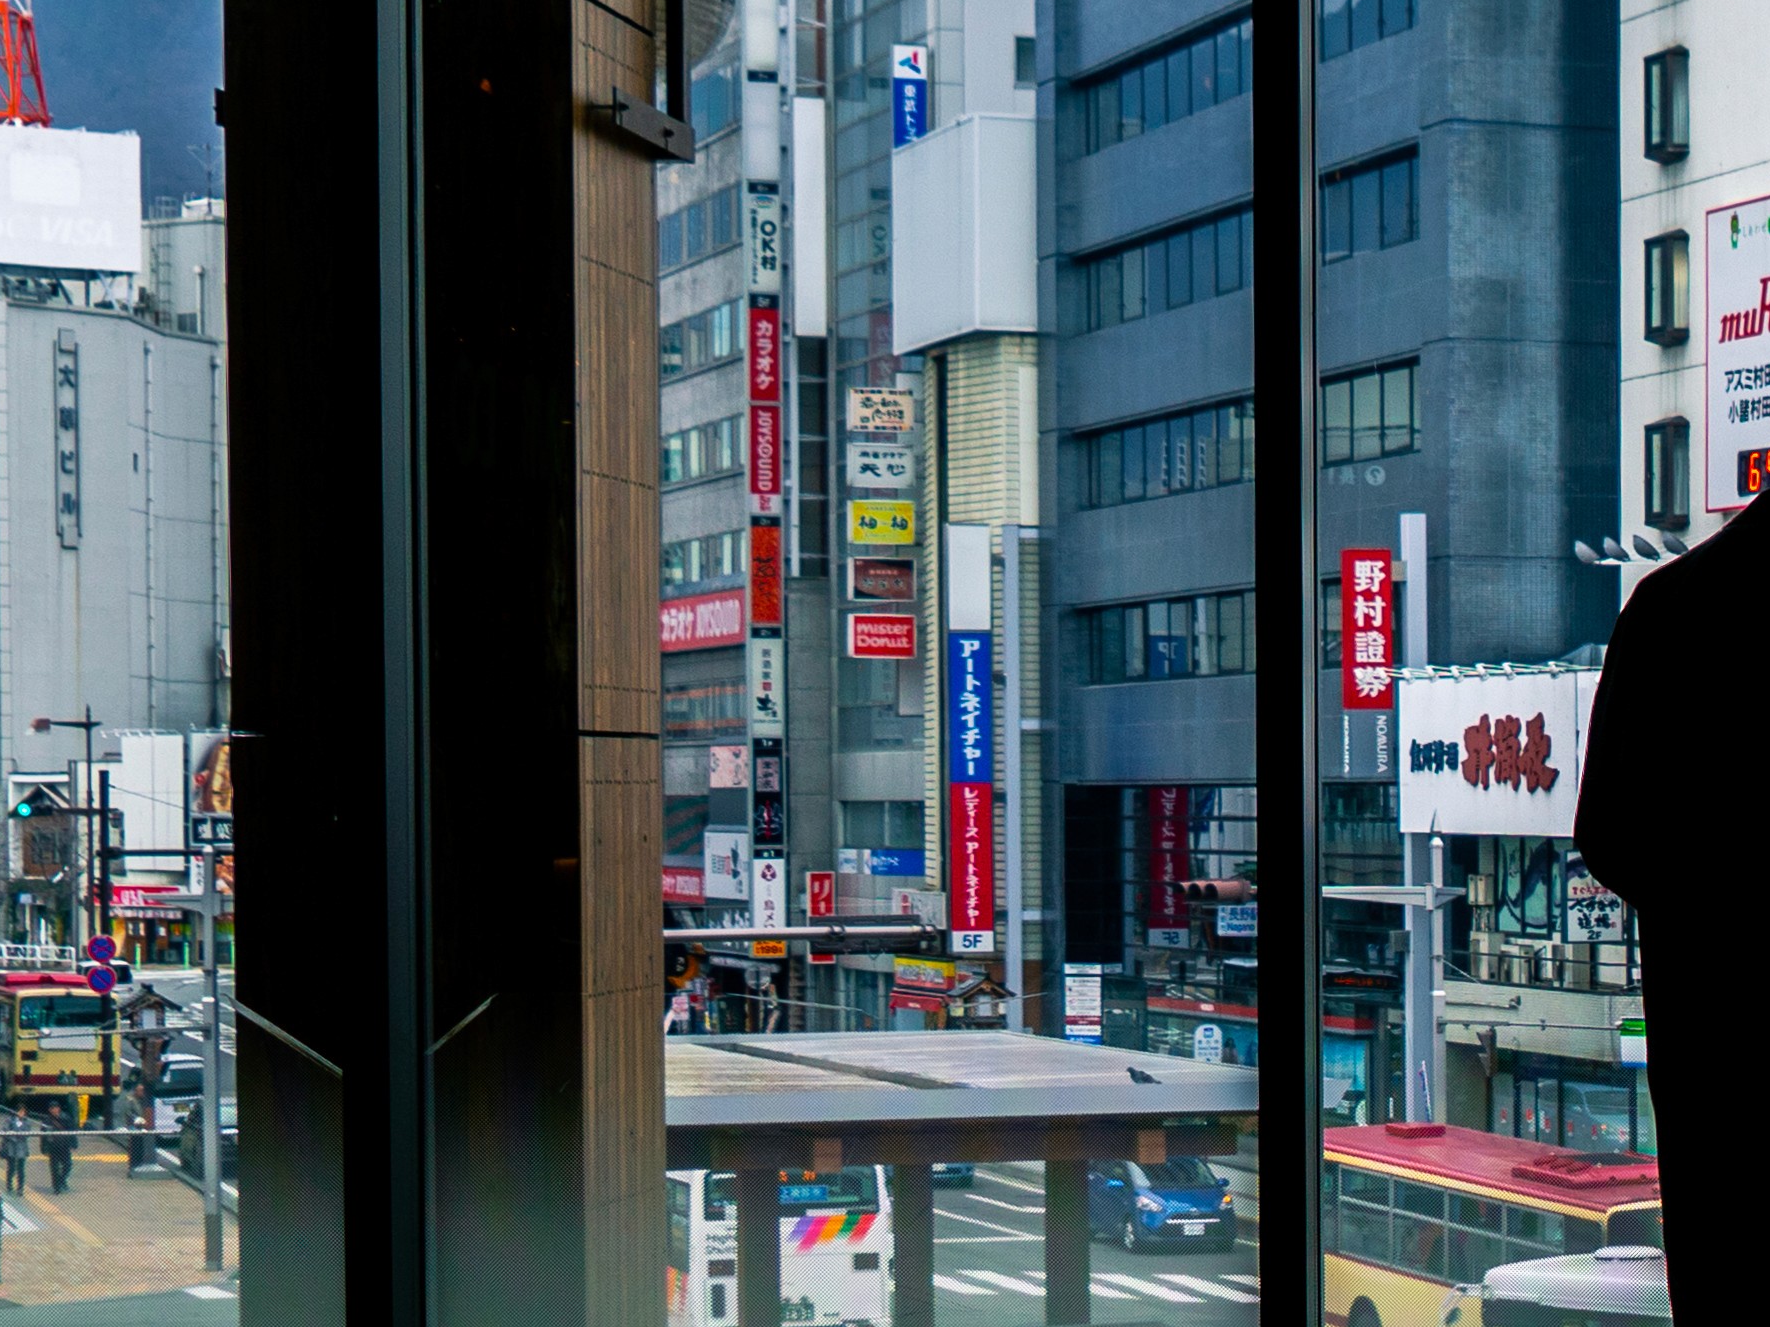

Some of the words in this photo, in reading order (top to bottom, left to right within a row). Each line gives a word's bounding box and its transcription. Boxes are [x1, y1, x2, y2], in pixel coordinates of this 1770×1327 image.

[756, 319, 774, 392] カラオケ
[856, 623, 910, 636] mister
[856, 636, 911, 650] Donut
[1352, 559, 1388, 700] 野村證券
[964, 636, 983, 776] アートネイチャー
[1376, 715, 1389, 774] NOMURA
[963, 785, 978, 840] レディース
[965, 841, 979, 930] アートネイチャー
[961, 933, 983, 950] 5F
